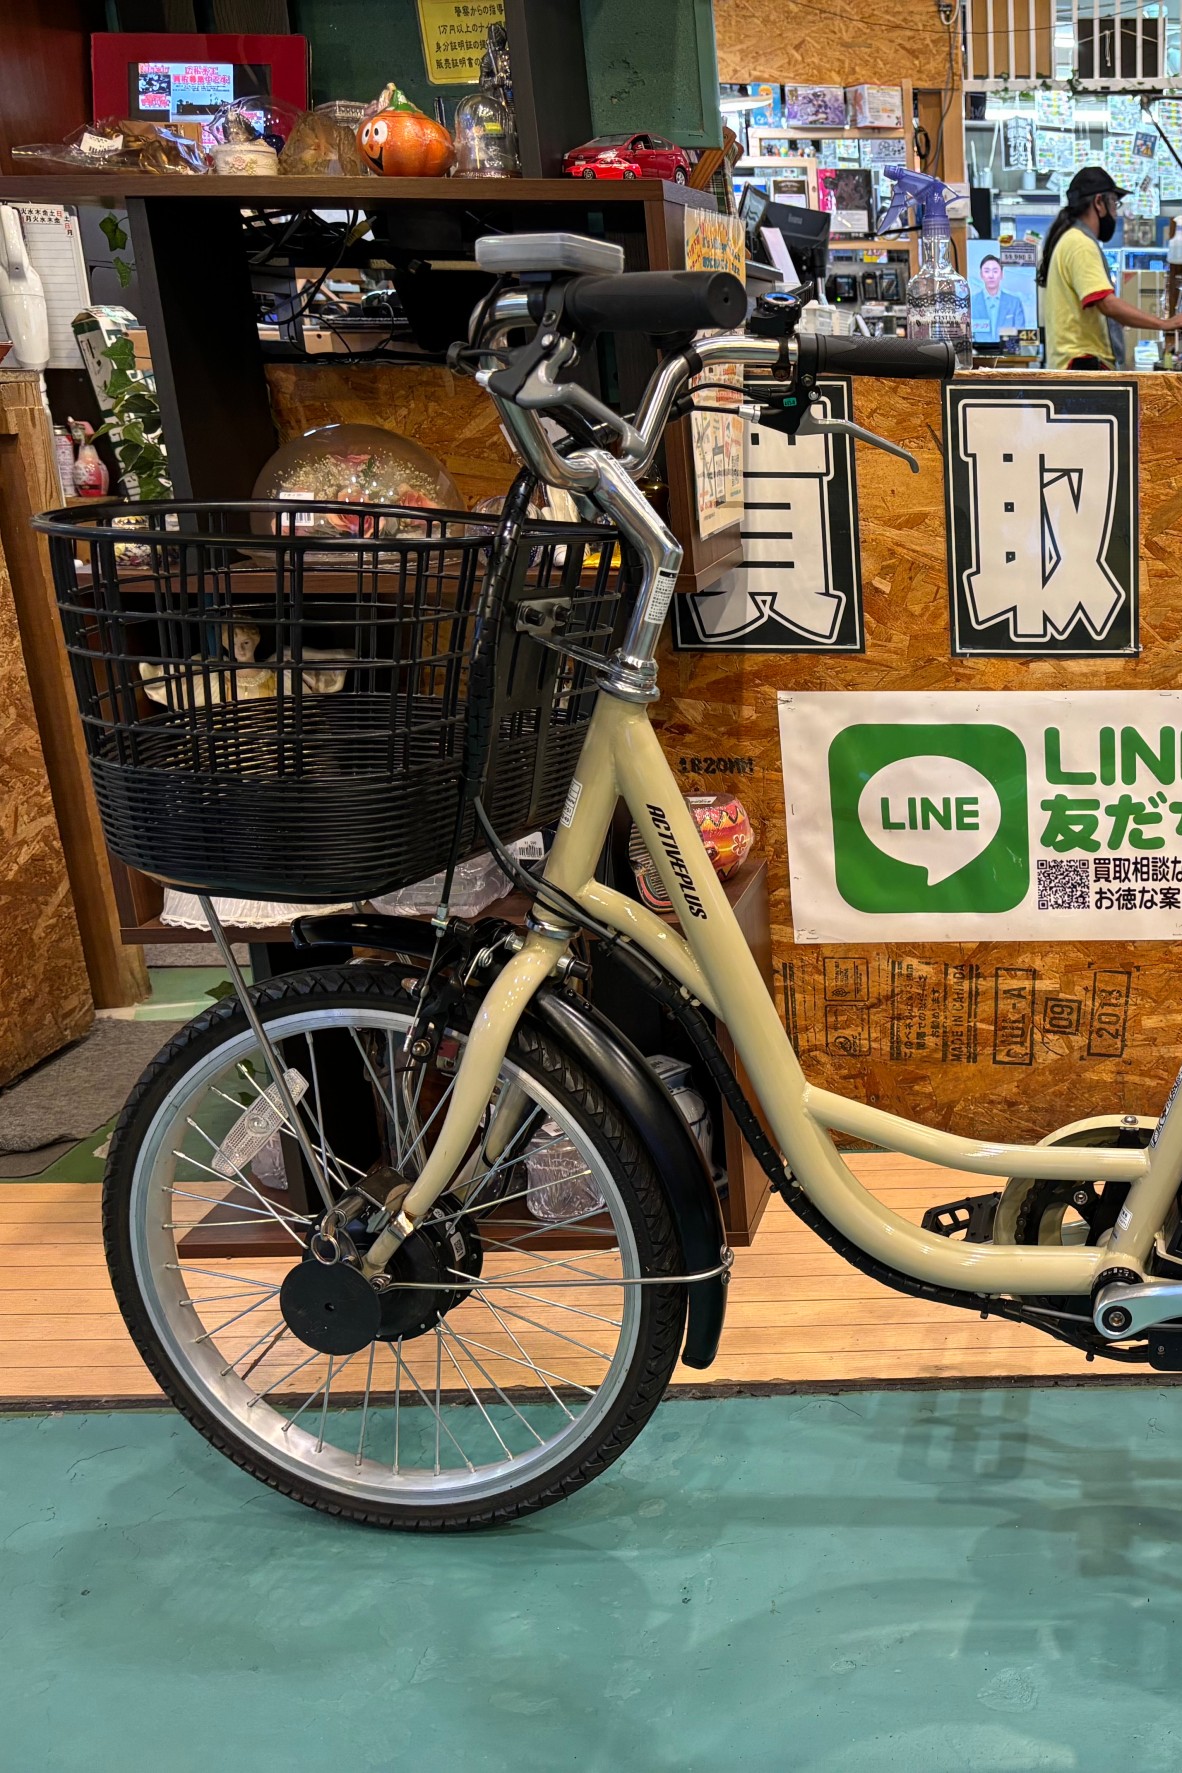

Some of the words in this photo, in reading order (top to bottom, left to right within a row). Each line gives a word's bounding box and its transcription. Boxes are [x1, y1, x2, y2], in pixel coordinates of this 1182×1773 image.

[1019, 330, 1037, 341] 4K
[881, 796, 980, 831] LINE
[645, 803, 708, 920] ACTIVEPLUS
[951, 964, 966, 1012] CANADA
[951, 1015, 964, 1027] IN
[1048, 1003, 1074, 1030] 09
[950, 1030, 964, 1062] MADE
